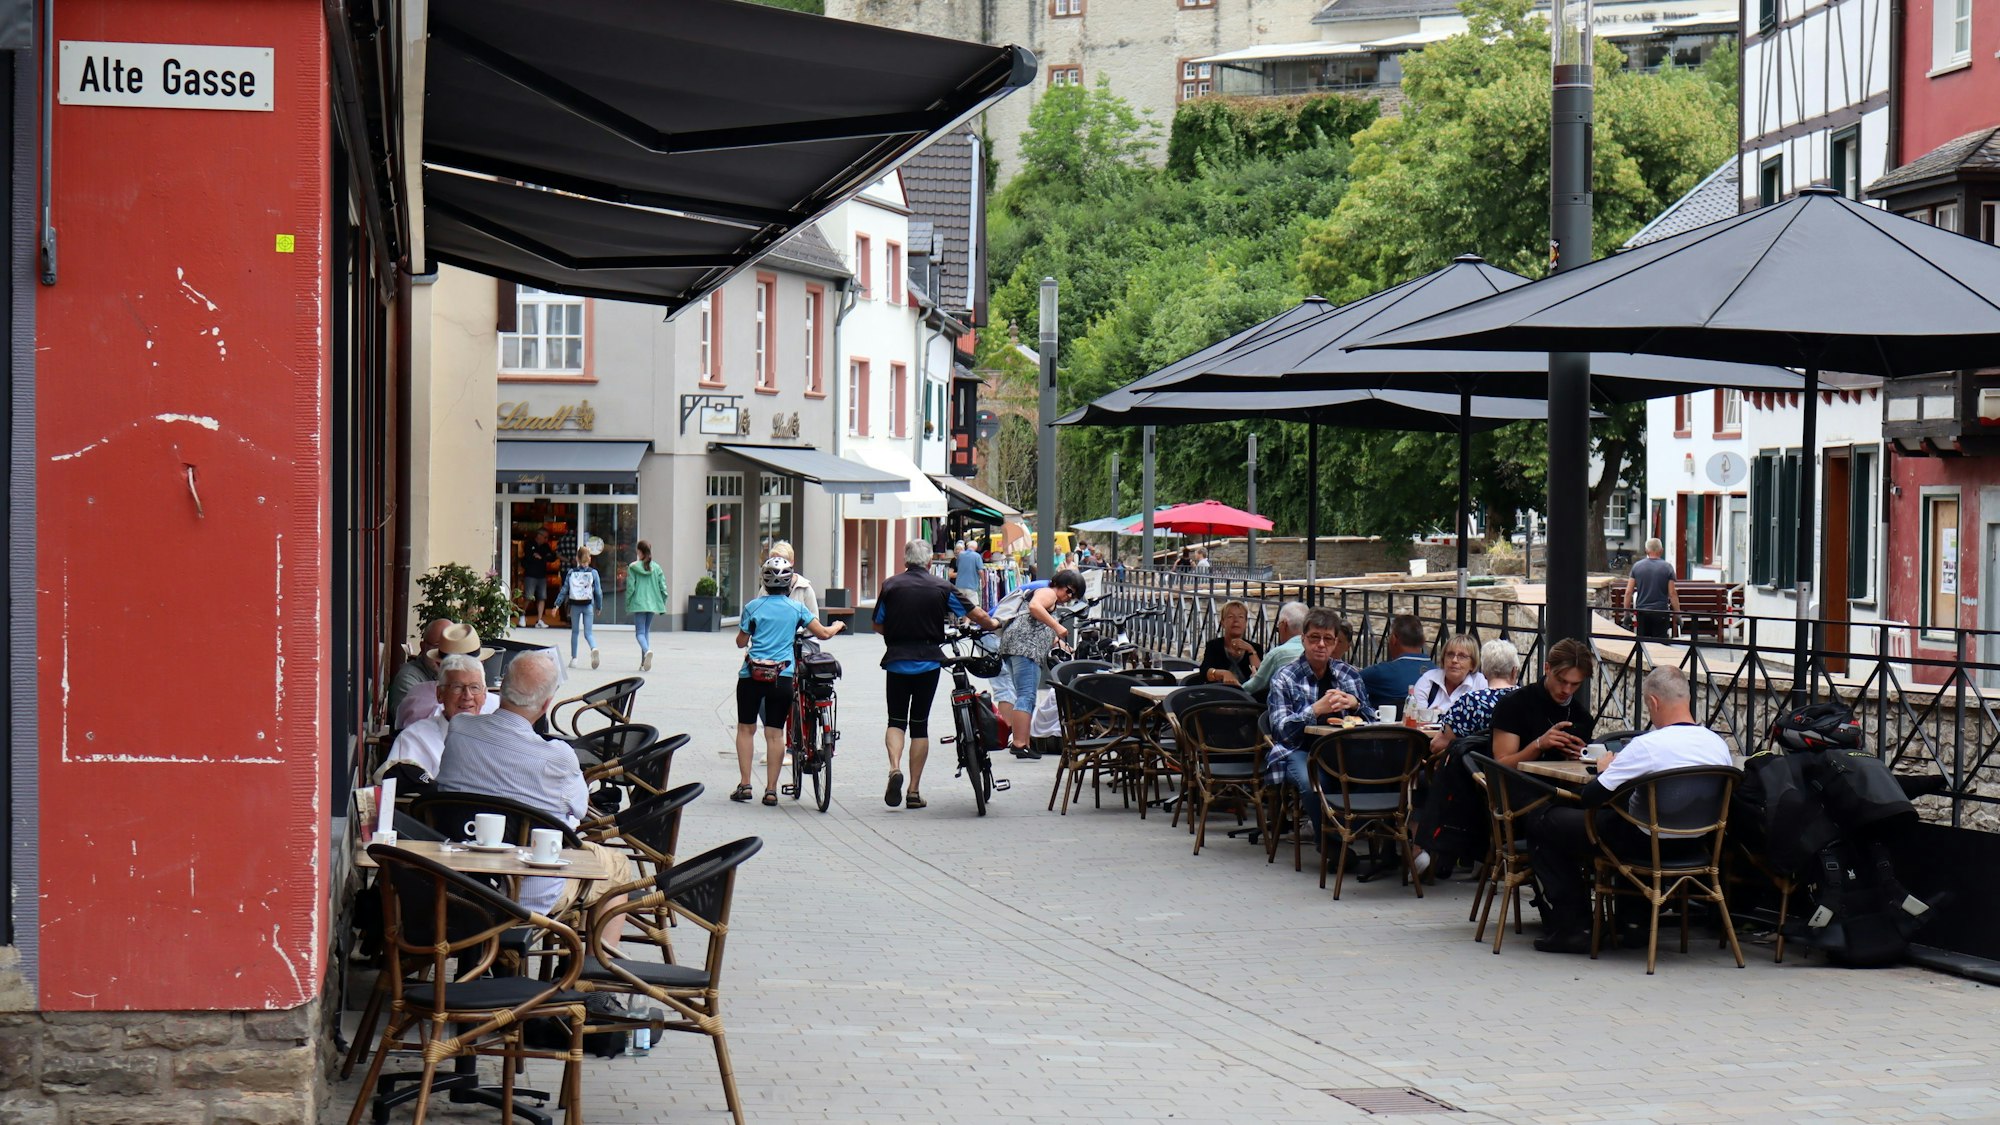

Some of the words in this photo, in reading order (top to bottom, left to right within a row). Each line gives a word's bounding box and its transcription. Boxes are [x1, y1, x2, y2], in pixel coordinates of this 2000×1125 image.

[79, 55, 143, 94] Alte
[162, 58, 255, 97] Gasse
[497, 400, 575, 431] Lindt
